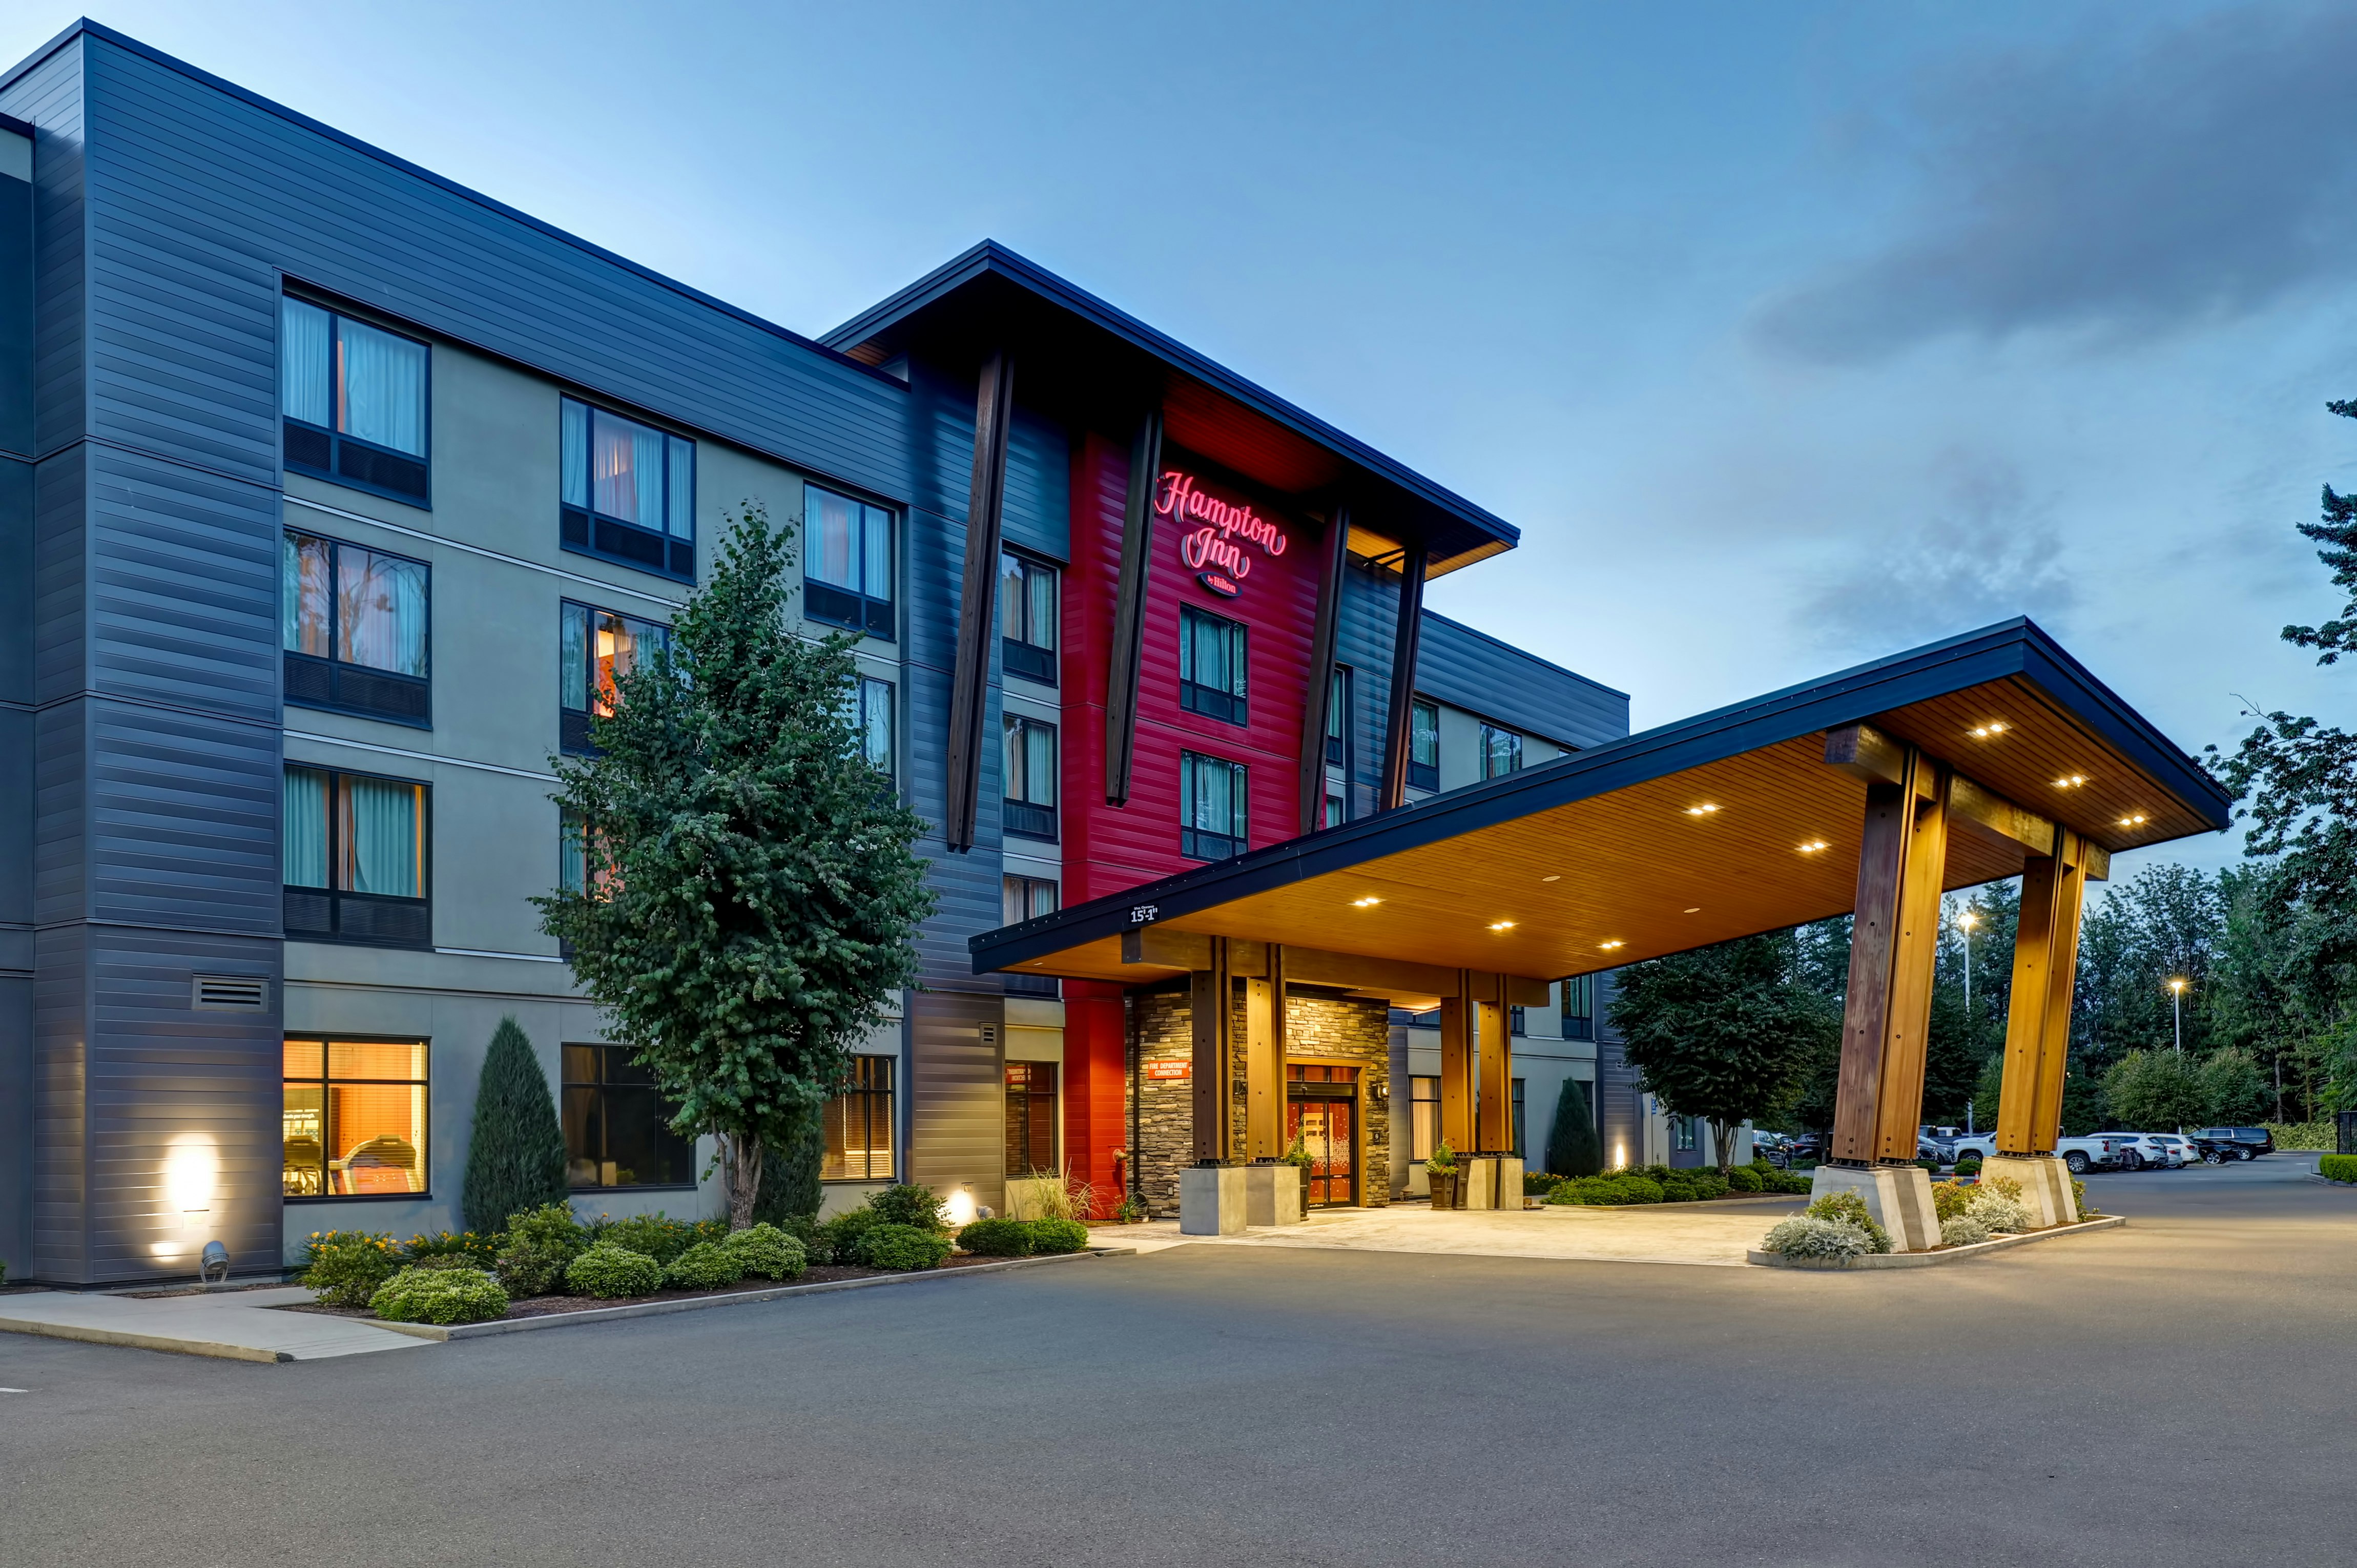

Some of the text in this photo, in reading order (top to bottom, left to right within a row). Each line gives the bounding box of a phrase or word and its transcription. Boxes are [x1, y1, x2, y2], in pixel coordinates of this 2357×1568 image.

[1154, 471, 1286, 556] Hampton
[1185, 527, 1250, 579] Inn
[1207, 574, 1236, 594] by Hilton
